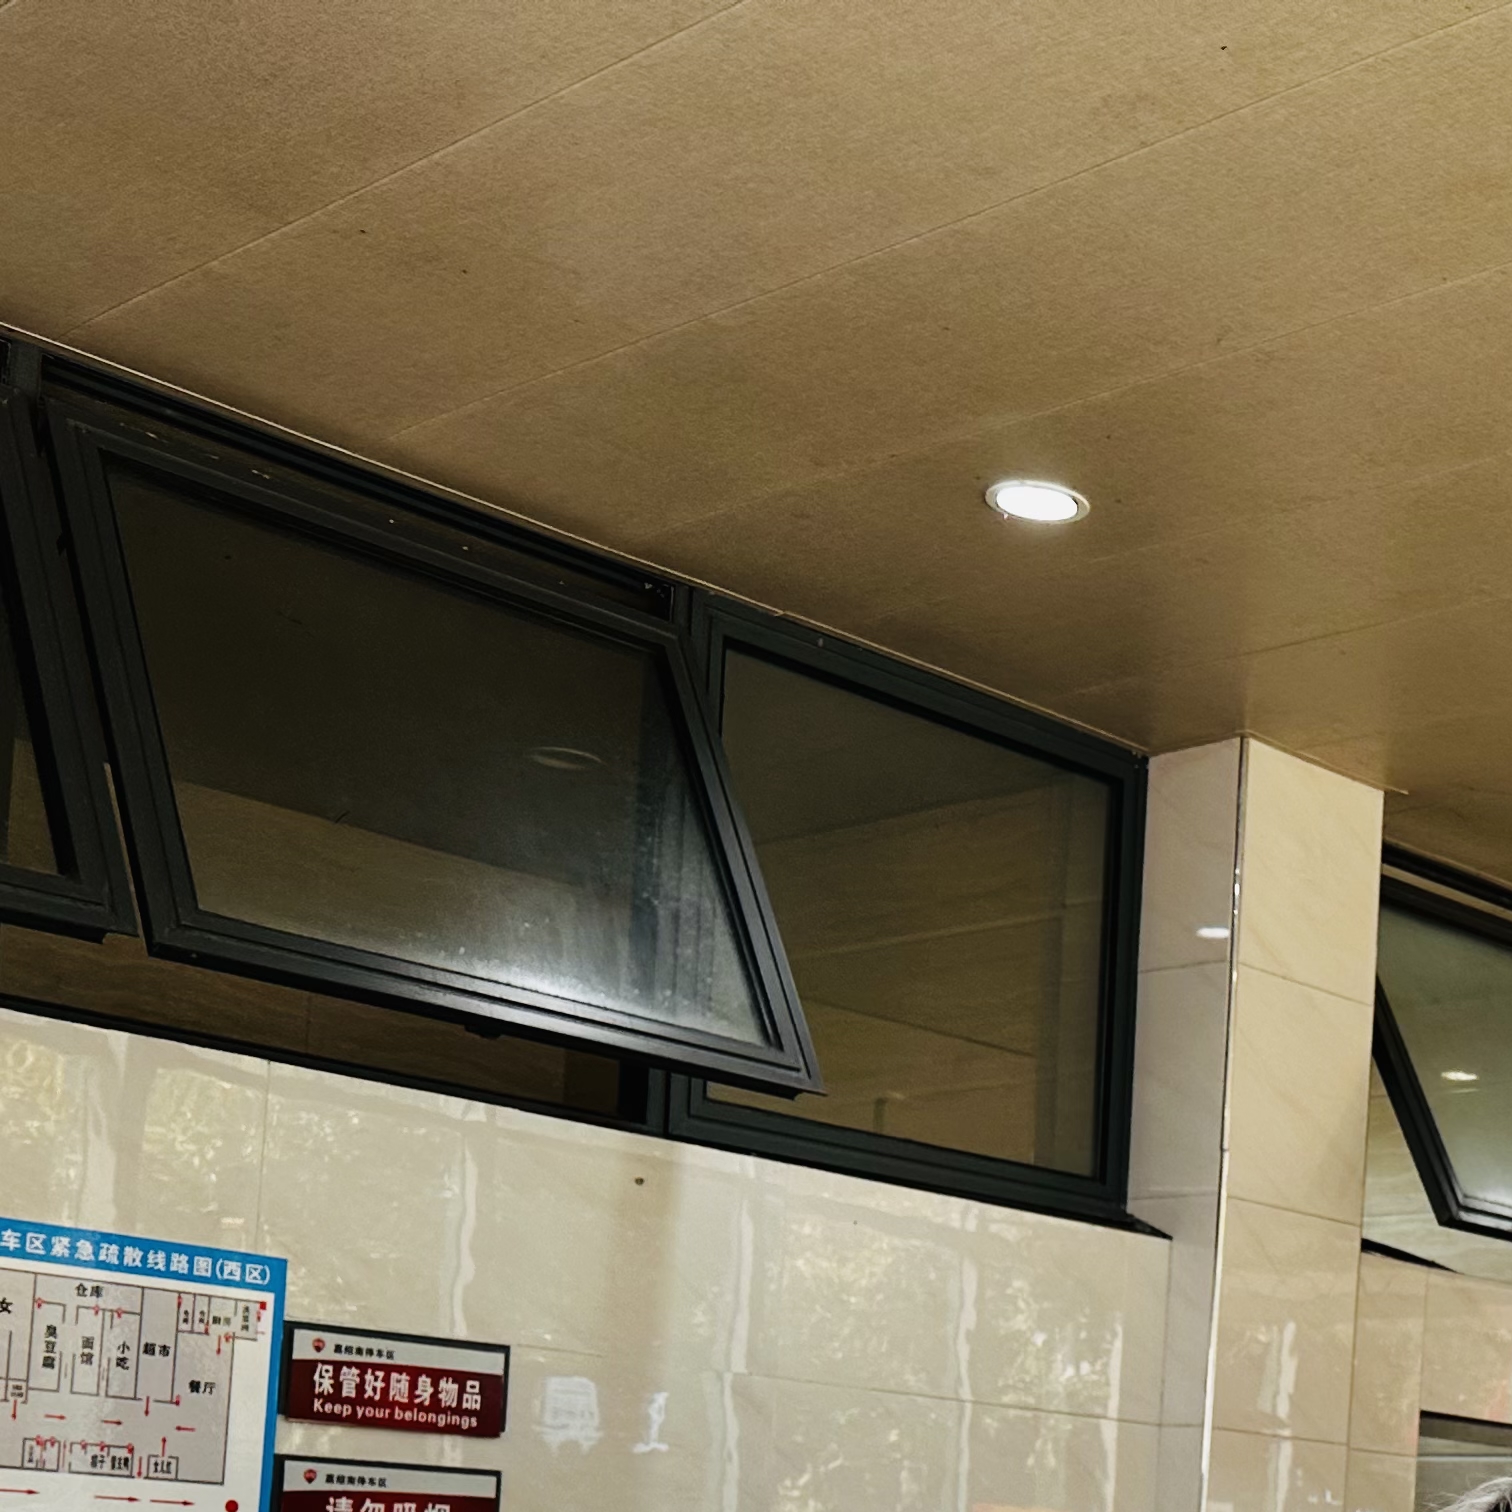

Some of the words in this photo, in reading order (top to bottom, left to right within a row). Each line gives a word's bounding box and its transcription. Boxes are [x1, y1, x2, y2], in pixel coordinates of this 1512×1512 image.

[75, 1282, 104, 1299] 仓库
[115, 1340, 131, 1371] 小吃
[142, 1341, 172, 1358] 超市
[188, 1379, 216, 1395] 餐厅
[313, 1362, 482, 1411] 保管好随身物品
[313, 1397, 352, 1418] Keep
[356, 1404, 391, 1420] your
[394, 1406, 478, 1429] belongings
